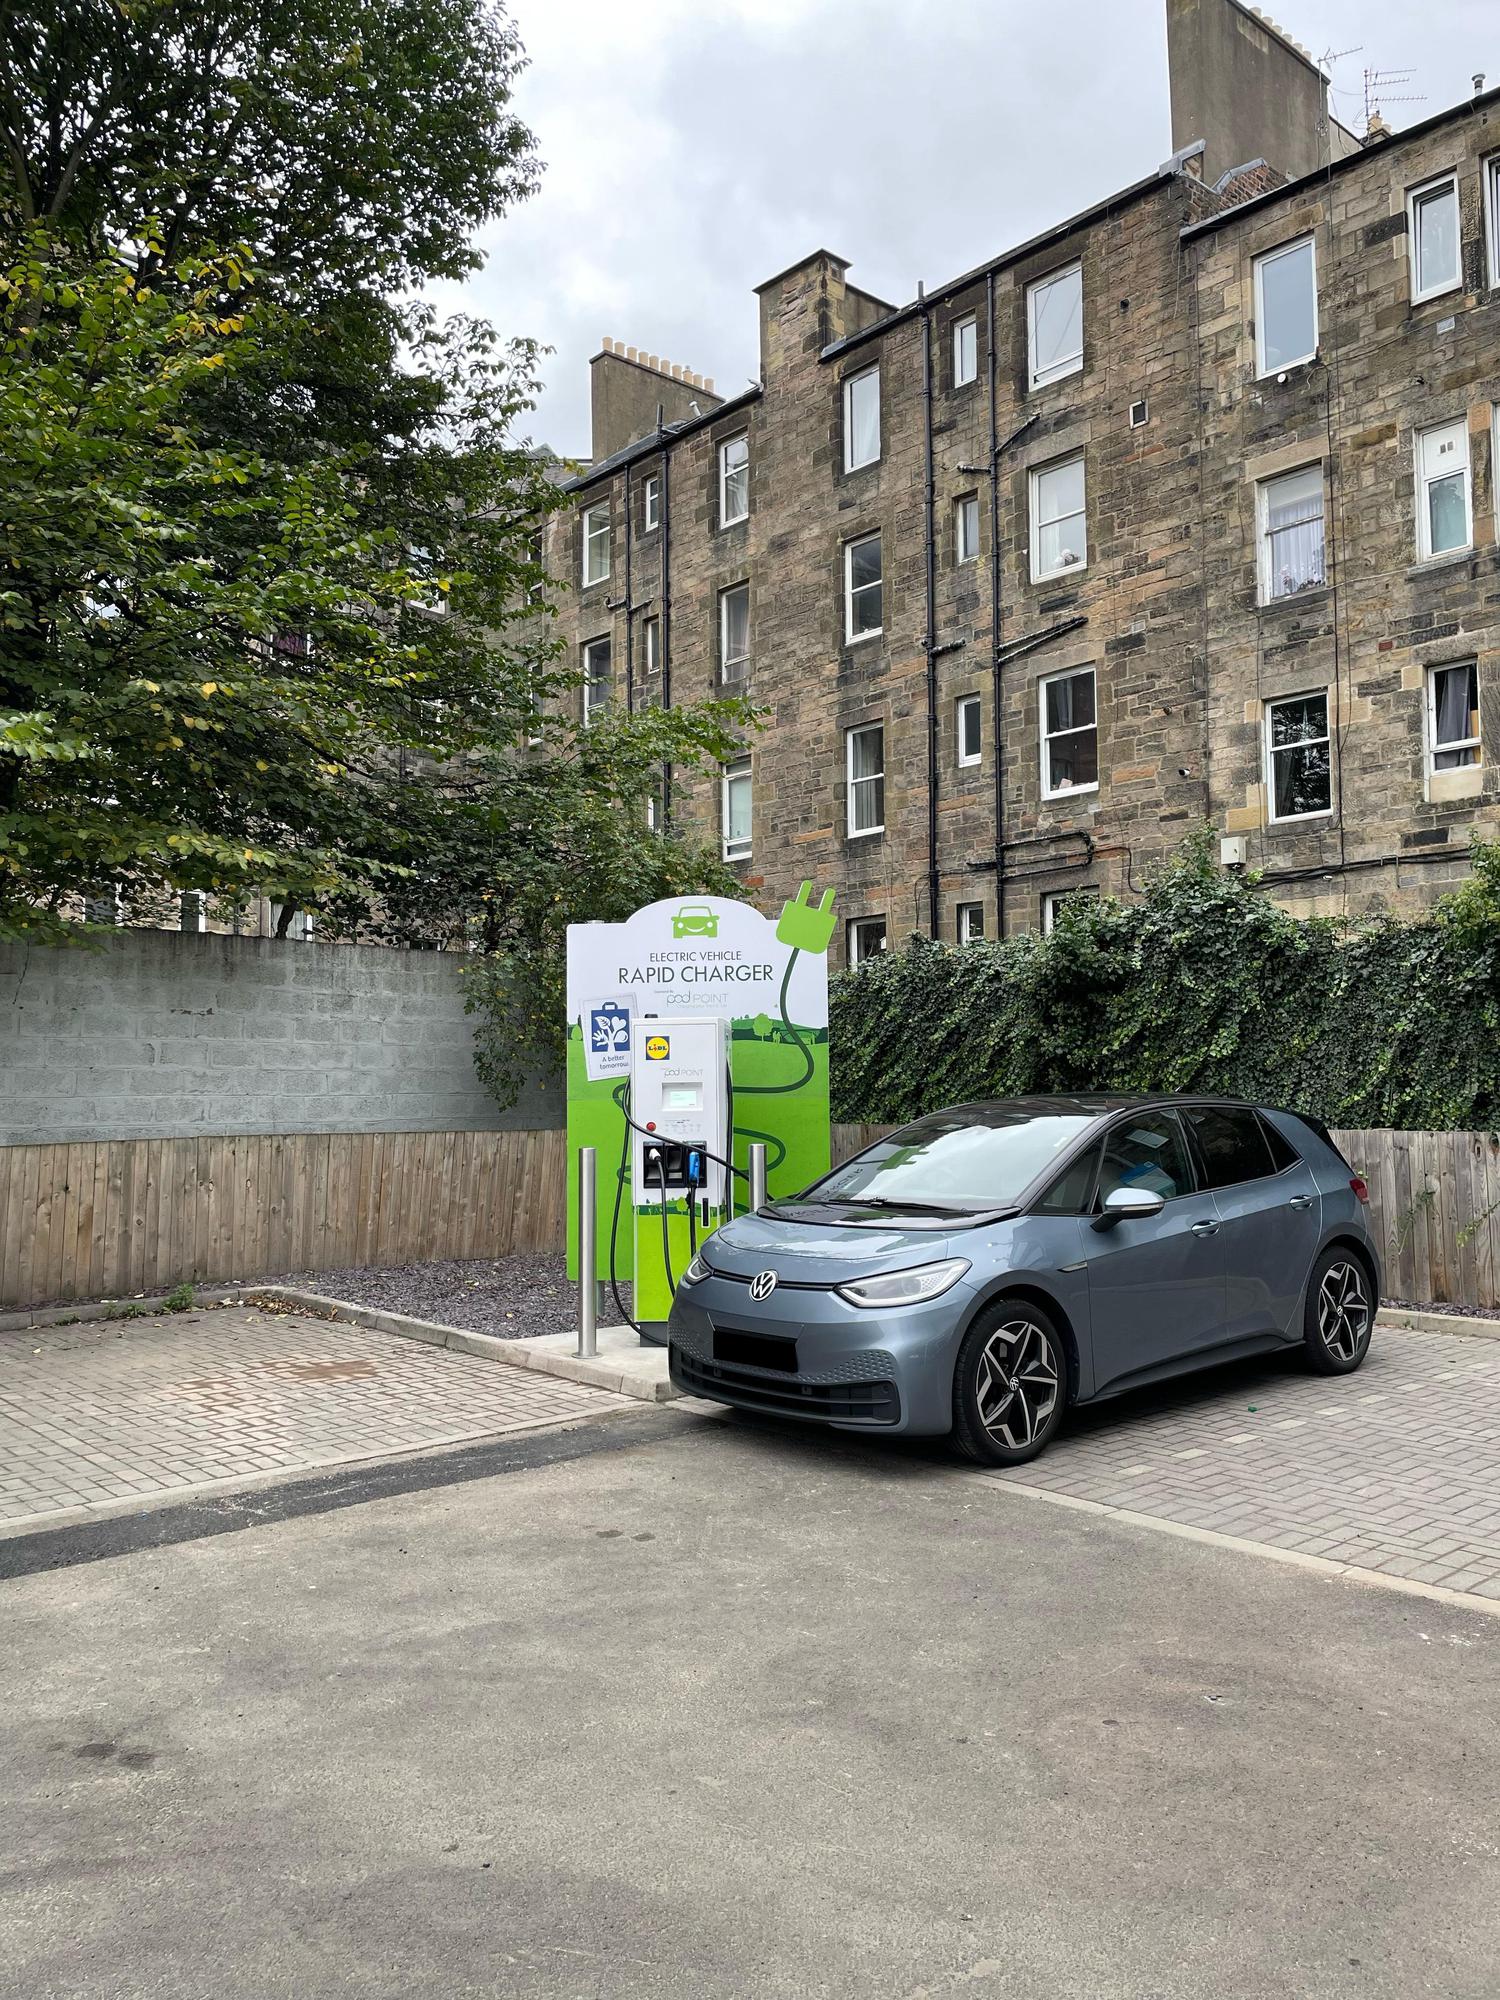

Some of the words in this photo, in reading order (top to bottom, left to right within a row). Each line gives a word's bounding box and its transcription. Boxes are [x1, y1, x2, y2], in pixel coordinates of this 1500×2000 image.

[650, 952, 697, 963] ELECTRIC
[699, 951, 742, 961] VEHICLE
[619, 967, 675, 984] RAPID
[681, 964, 774, 983] CHARGER
[666, 990, 691, 1008] pod
[693, 993, 729, 1004] POINT
[750, 1270, 777, 1301] VW
